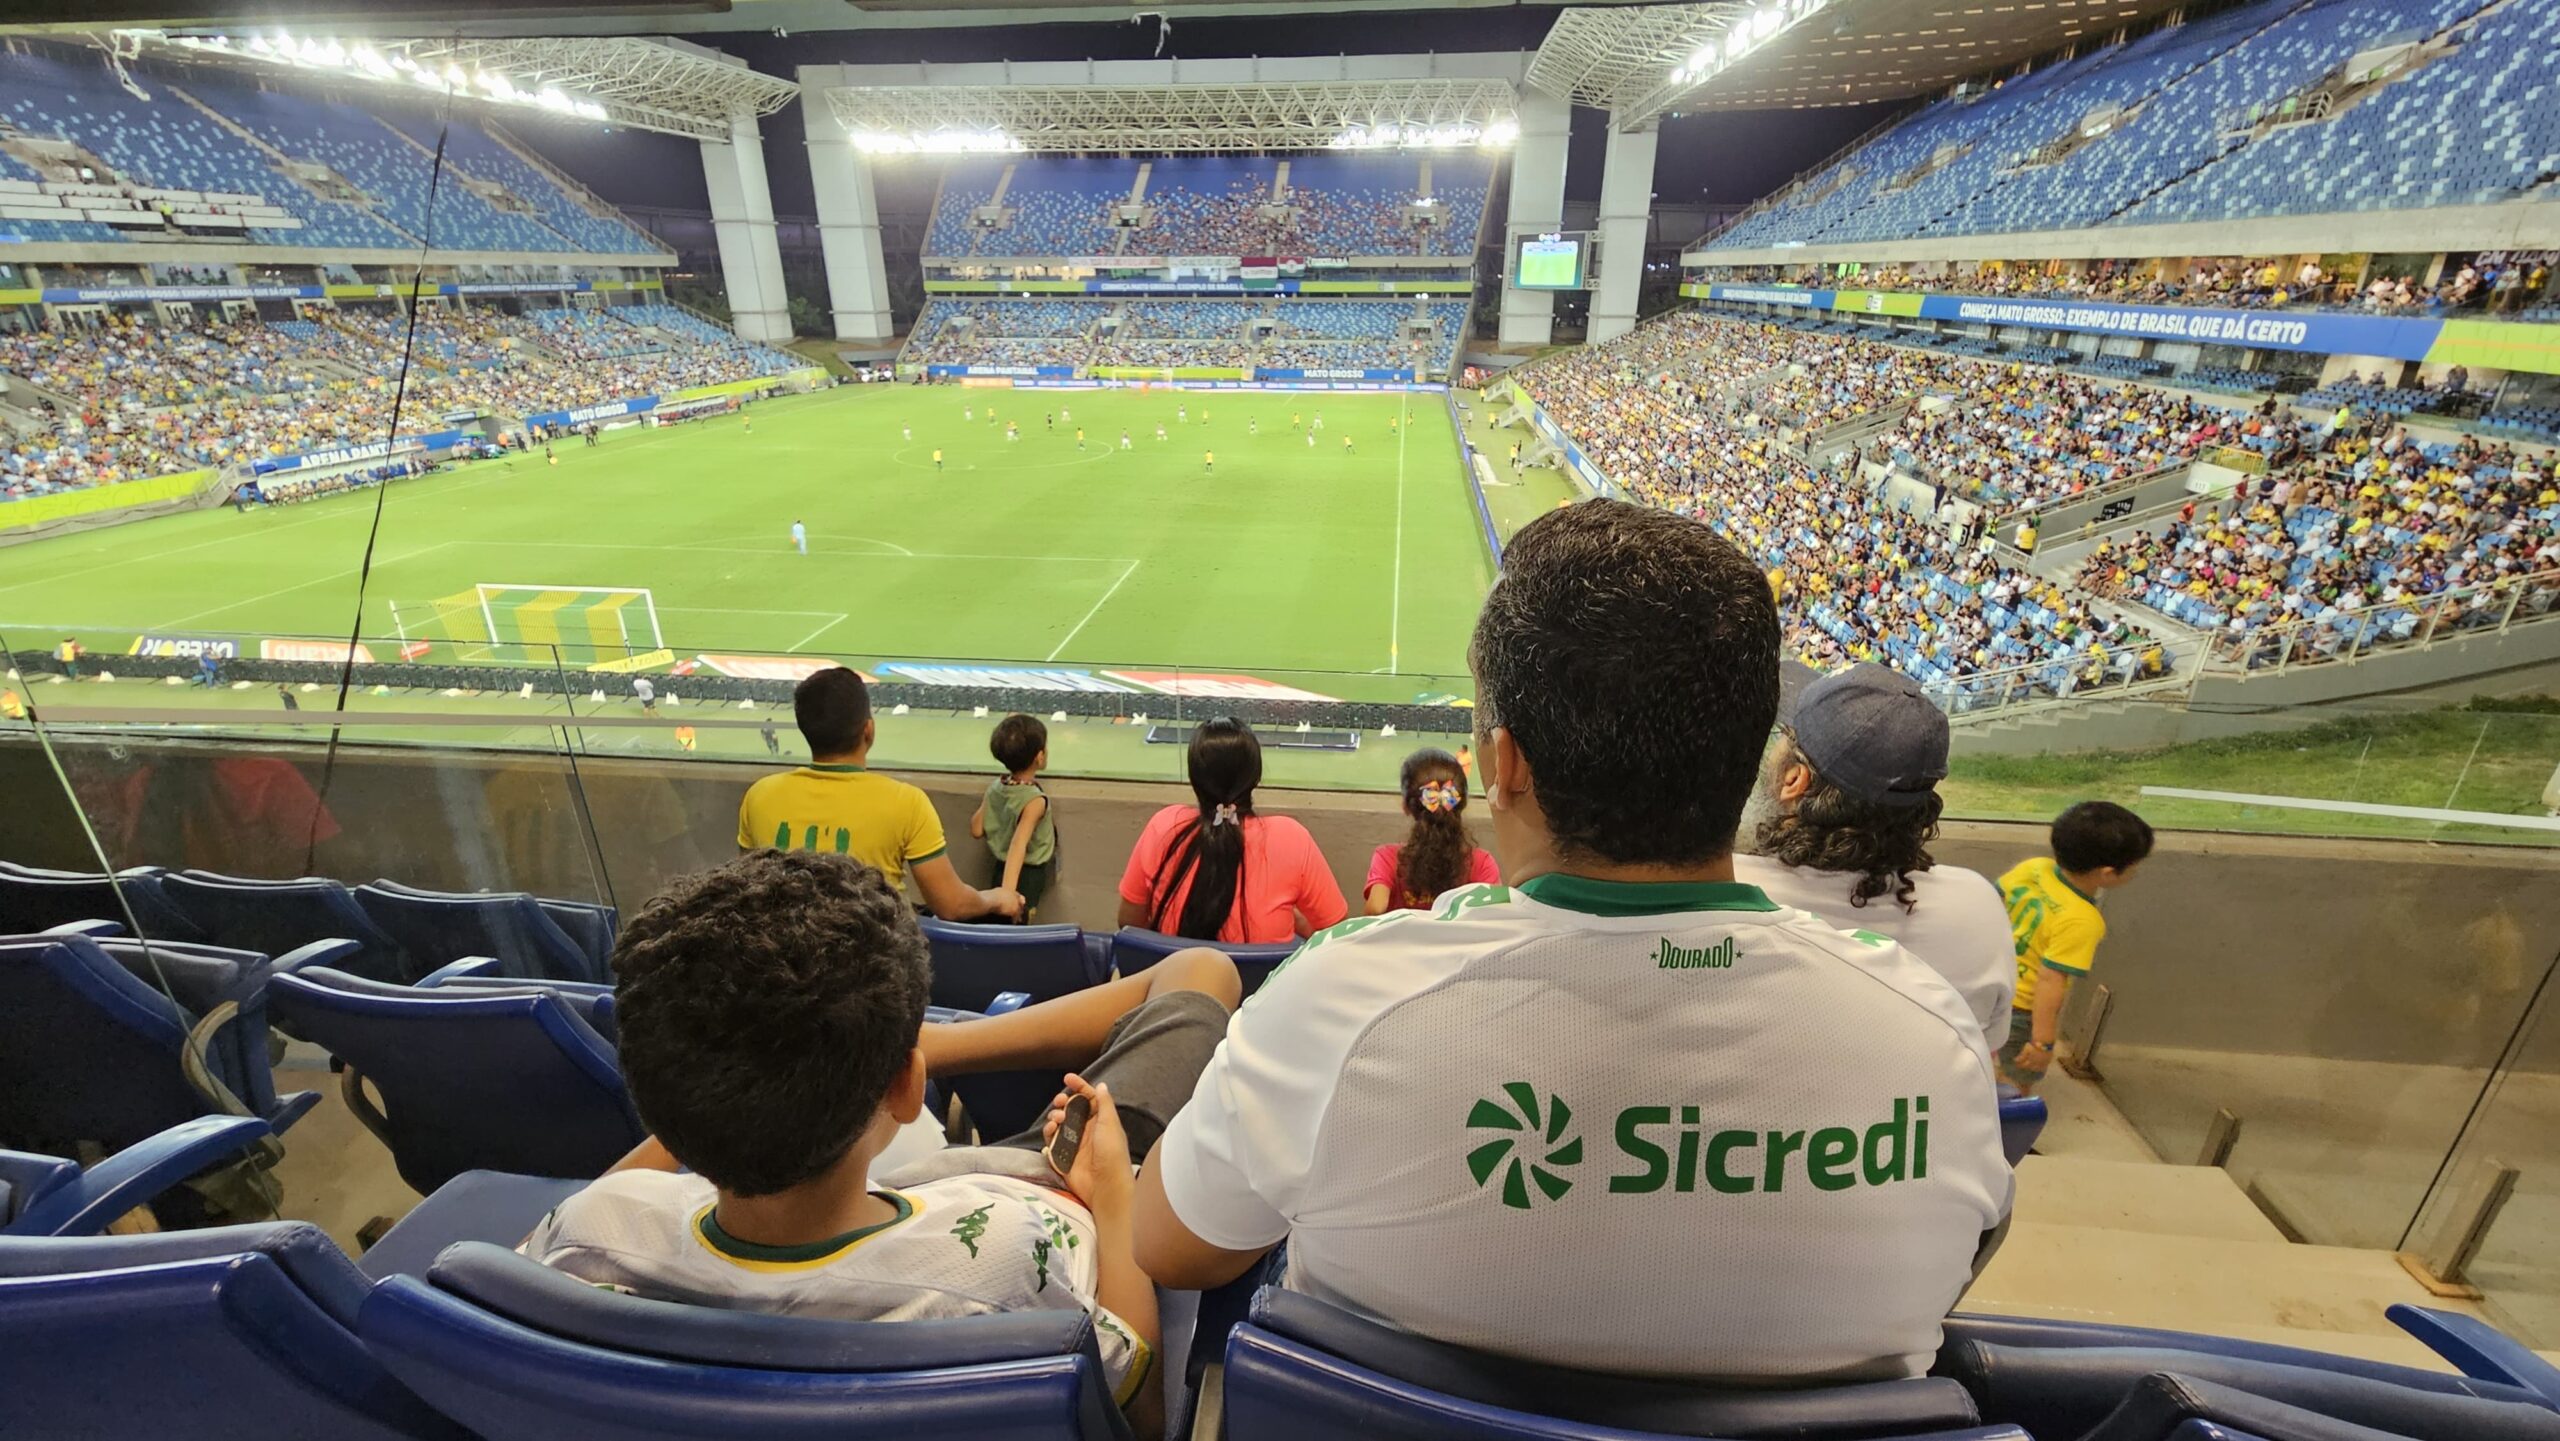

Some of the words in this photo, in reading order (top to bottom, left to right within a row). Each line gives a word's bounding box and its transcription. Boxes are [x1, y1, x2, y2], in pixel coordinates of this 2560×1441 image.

[1959, 302, 1999, 323] CONHEÇA
[1997, 304, 2024, 322] MATO
[2023, 307, 2065, 325] GROSSO:
[2066, 309, 2121, 329] EXEMPLO
[2119, 312, 2138, 331] DE
[2137, 313, 2188, 335] BRASIL
[2189, 316, 2216, 338] QUE
[2217, 313, 2248, 340] DÁ
[2247, 320, 2308, 345] CERTO
[1304, 369, 1328, 377] MATO
[1329, 369, 1364, 378] GROSSO
[569, 408, 594, 422] MATO
[595, 403, 627, 418] GROSSO
[301, 449, 351, 468] ARENA
[1658, 936, 1734, 970] DOURADO
[1608, 1096, 1930, 1195] Sicredi
